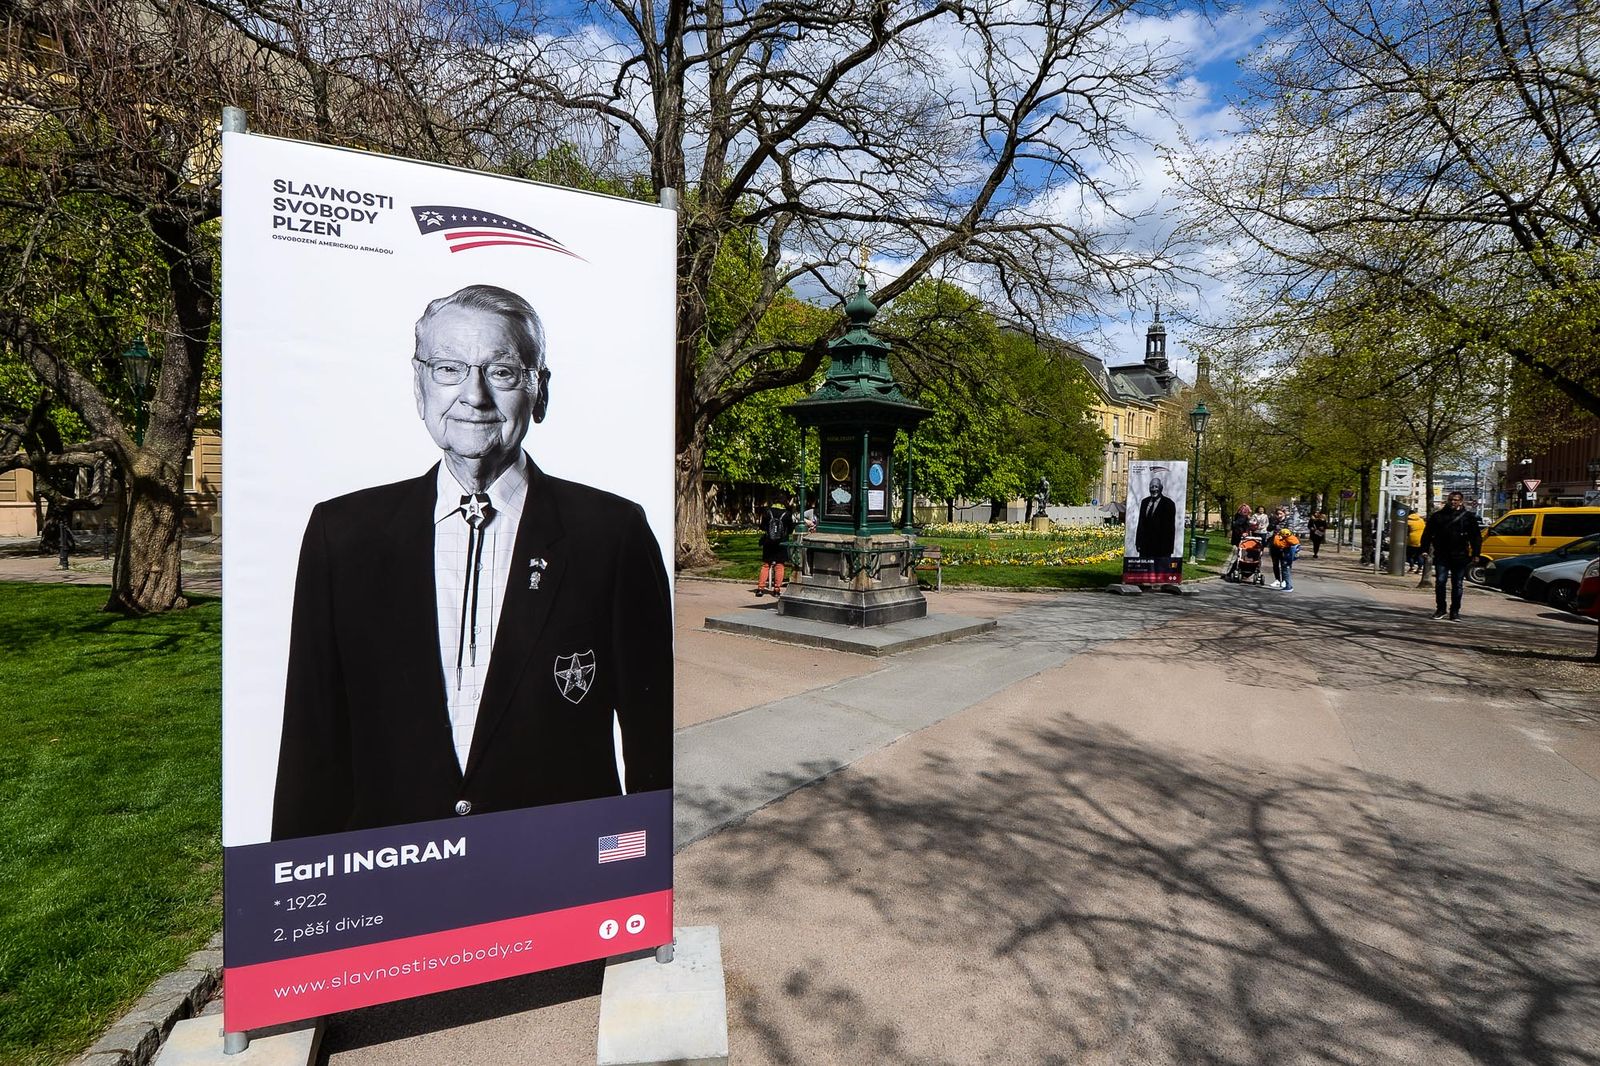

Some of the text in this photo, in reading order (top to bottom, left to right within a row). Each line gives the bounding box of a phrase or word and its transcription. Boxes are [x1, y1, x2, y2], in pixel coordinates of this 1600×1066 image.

[273, 179, 393, 209] SLAVNOSTI
[273, 197, 378, 224] SVOBODY
[273, 215, 341, 237] PLZEŇ
[272, 234, 394, 255] OSVOBOZENÍ AMERICKOU ARMÁDOU
[274, 837, 466, 884] Earl INGRAM
[286, 892, 327, 912] 1922
[273, 915, 384, 942] 2. pěší divize
[274, 942, 534, 999] www.slavnostisvobody.cz
